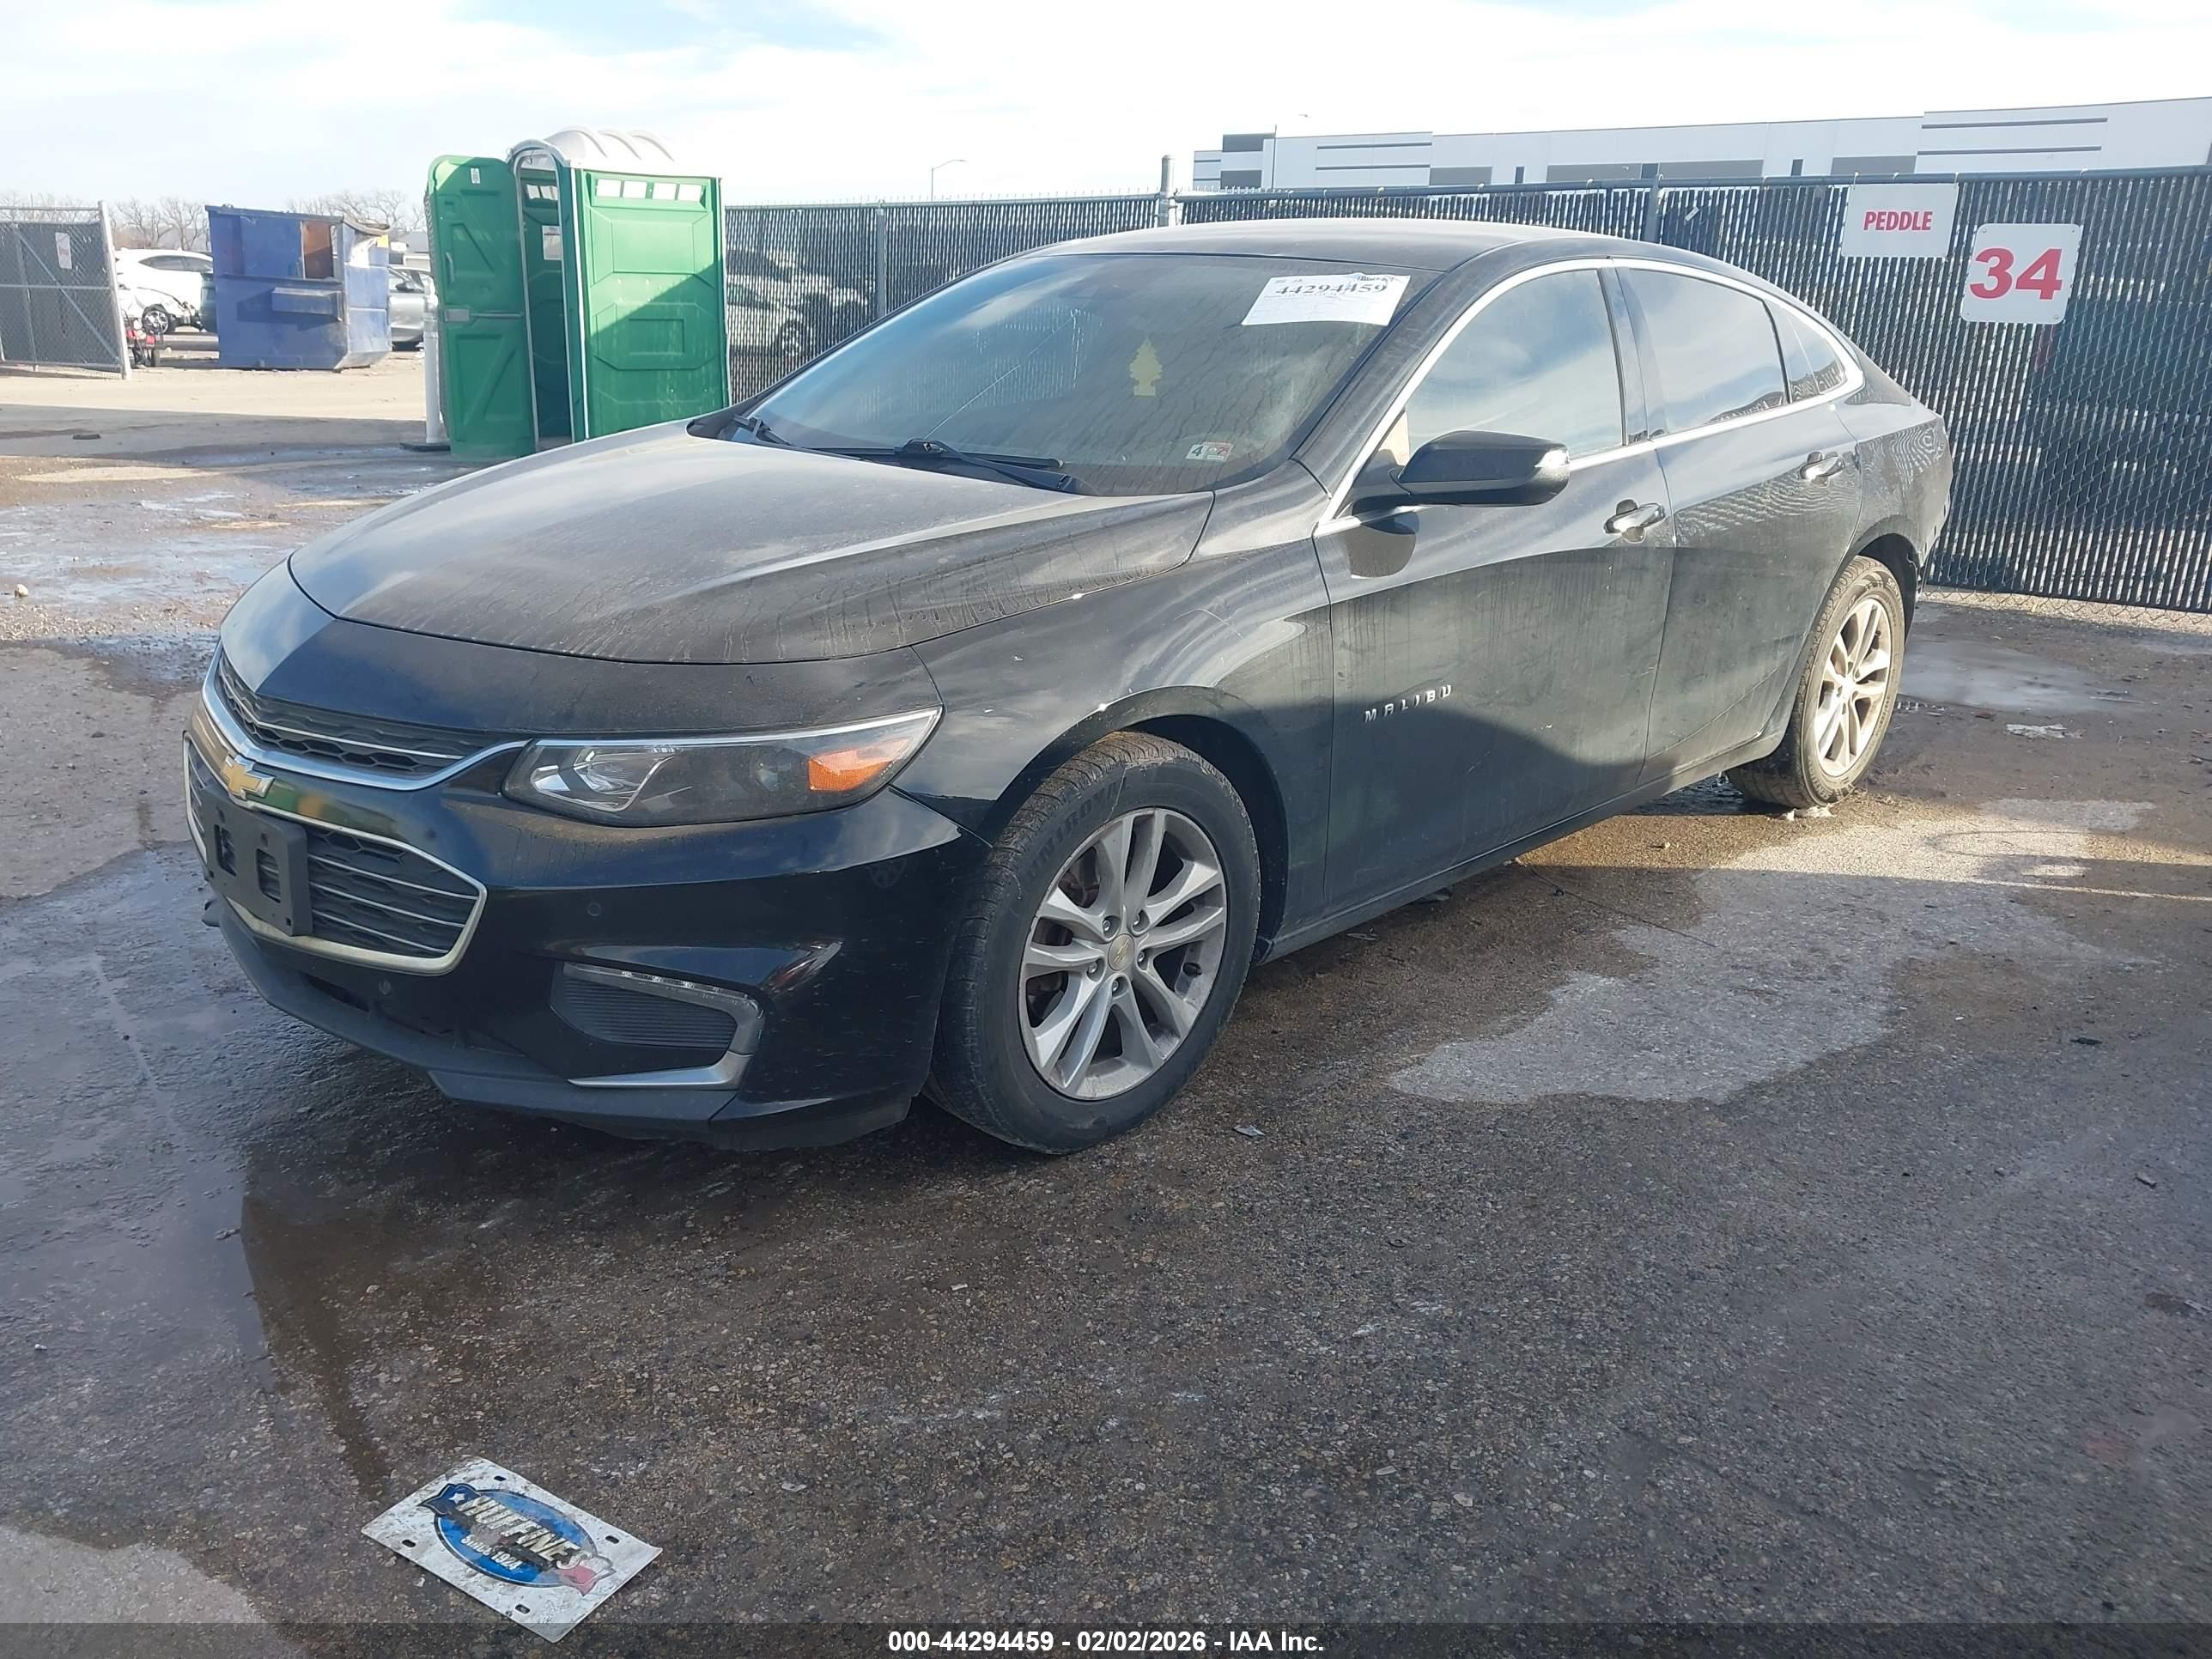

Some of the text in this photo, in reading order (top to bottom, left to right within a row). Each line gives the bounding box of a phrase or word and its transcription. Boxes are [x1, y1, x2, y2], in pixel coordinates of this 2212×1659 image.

[1863, 210, 1933, 231] PEDDLE
[1969, 247, 2063, 300] 34
[1275, 283, 1389, 295] 44294459
[1191, 446, 1204, 456] 4
[1364, 684, 1452, 723] MALIBU
[456, 1495, 592, 1570] HUFFINES
[490, 1550, 523, 1571] 1924
